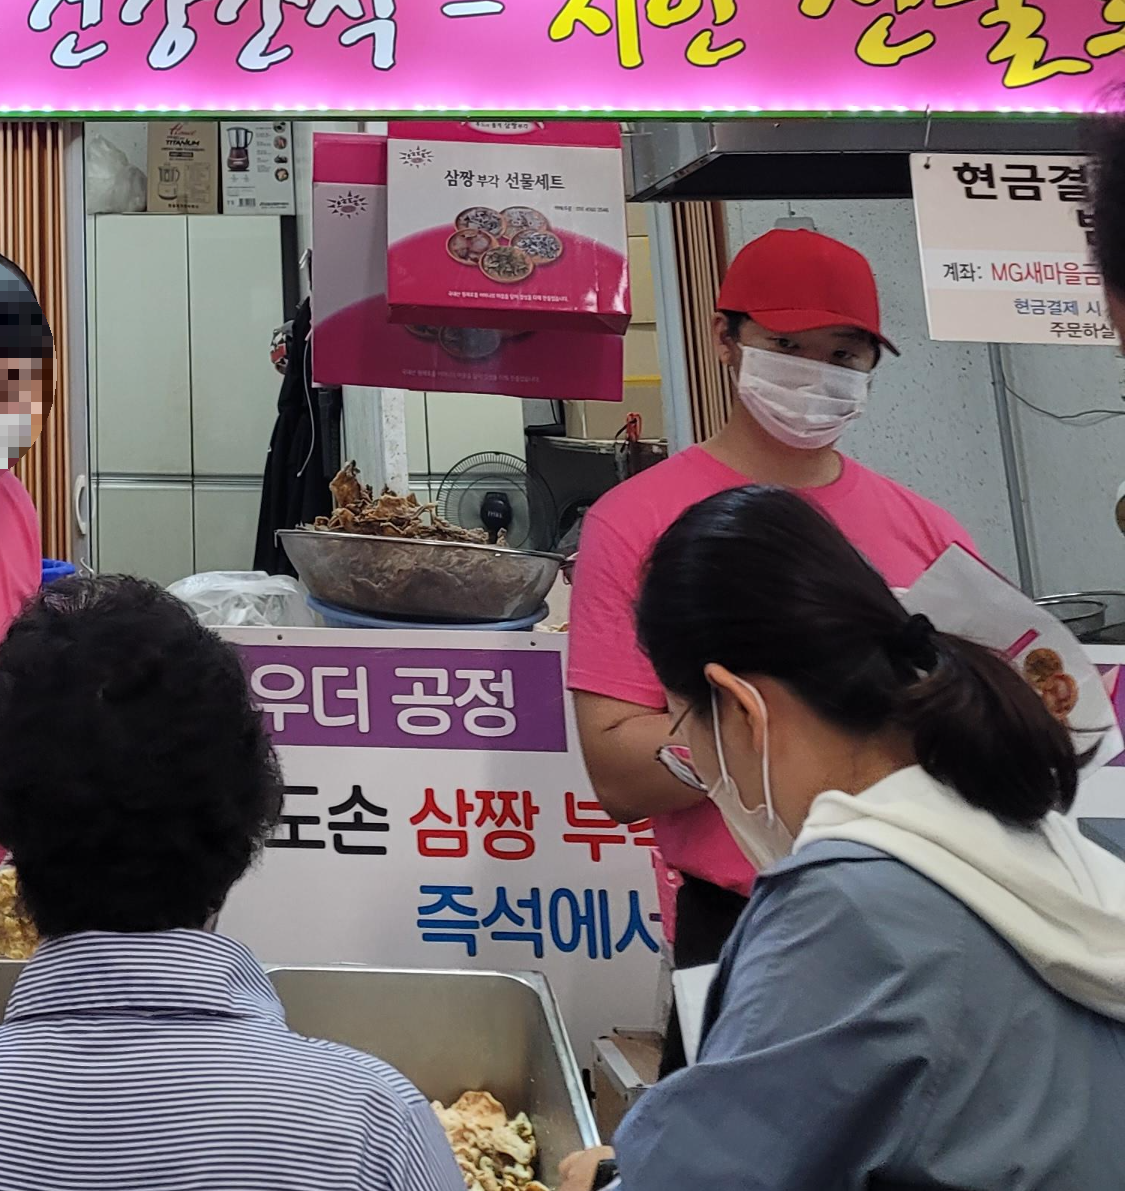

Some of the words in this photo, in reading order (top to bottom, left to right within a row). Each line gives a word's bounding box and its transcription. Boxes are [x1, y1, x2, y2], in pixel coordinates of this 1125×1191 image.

[444, 169, 474, 188] 삼짱
[476, 174, 500, 189] 부각
[505, 171, 566, 192] 선물세트
[943, 262, 983, 282] 계좌:
[1013, 298, 1079, 316] 현금결제
[1085, 300, 1102, 316] 시
[1049, 321, 1117, 340] 주문하실
[250, 663, 370, 734] 우더
[390, 666, 518, 738] 공정
[263, 784, 390, 855] 도손
[409, 787, 539, 861] 삼짱
